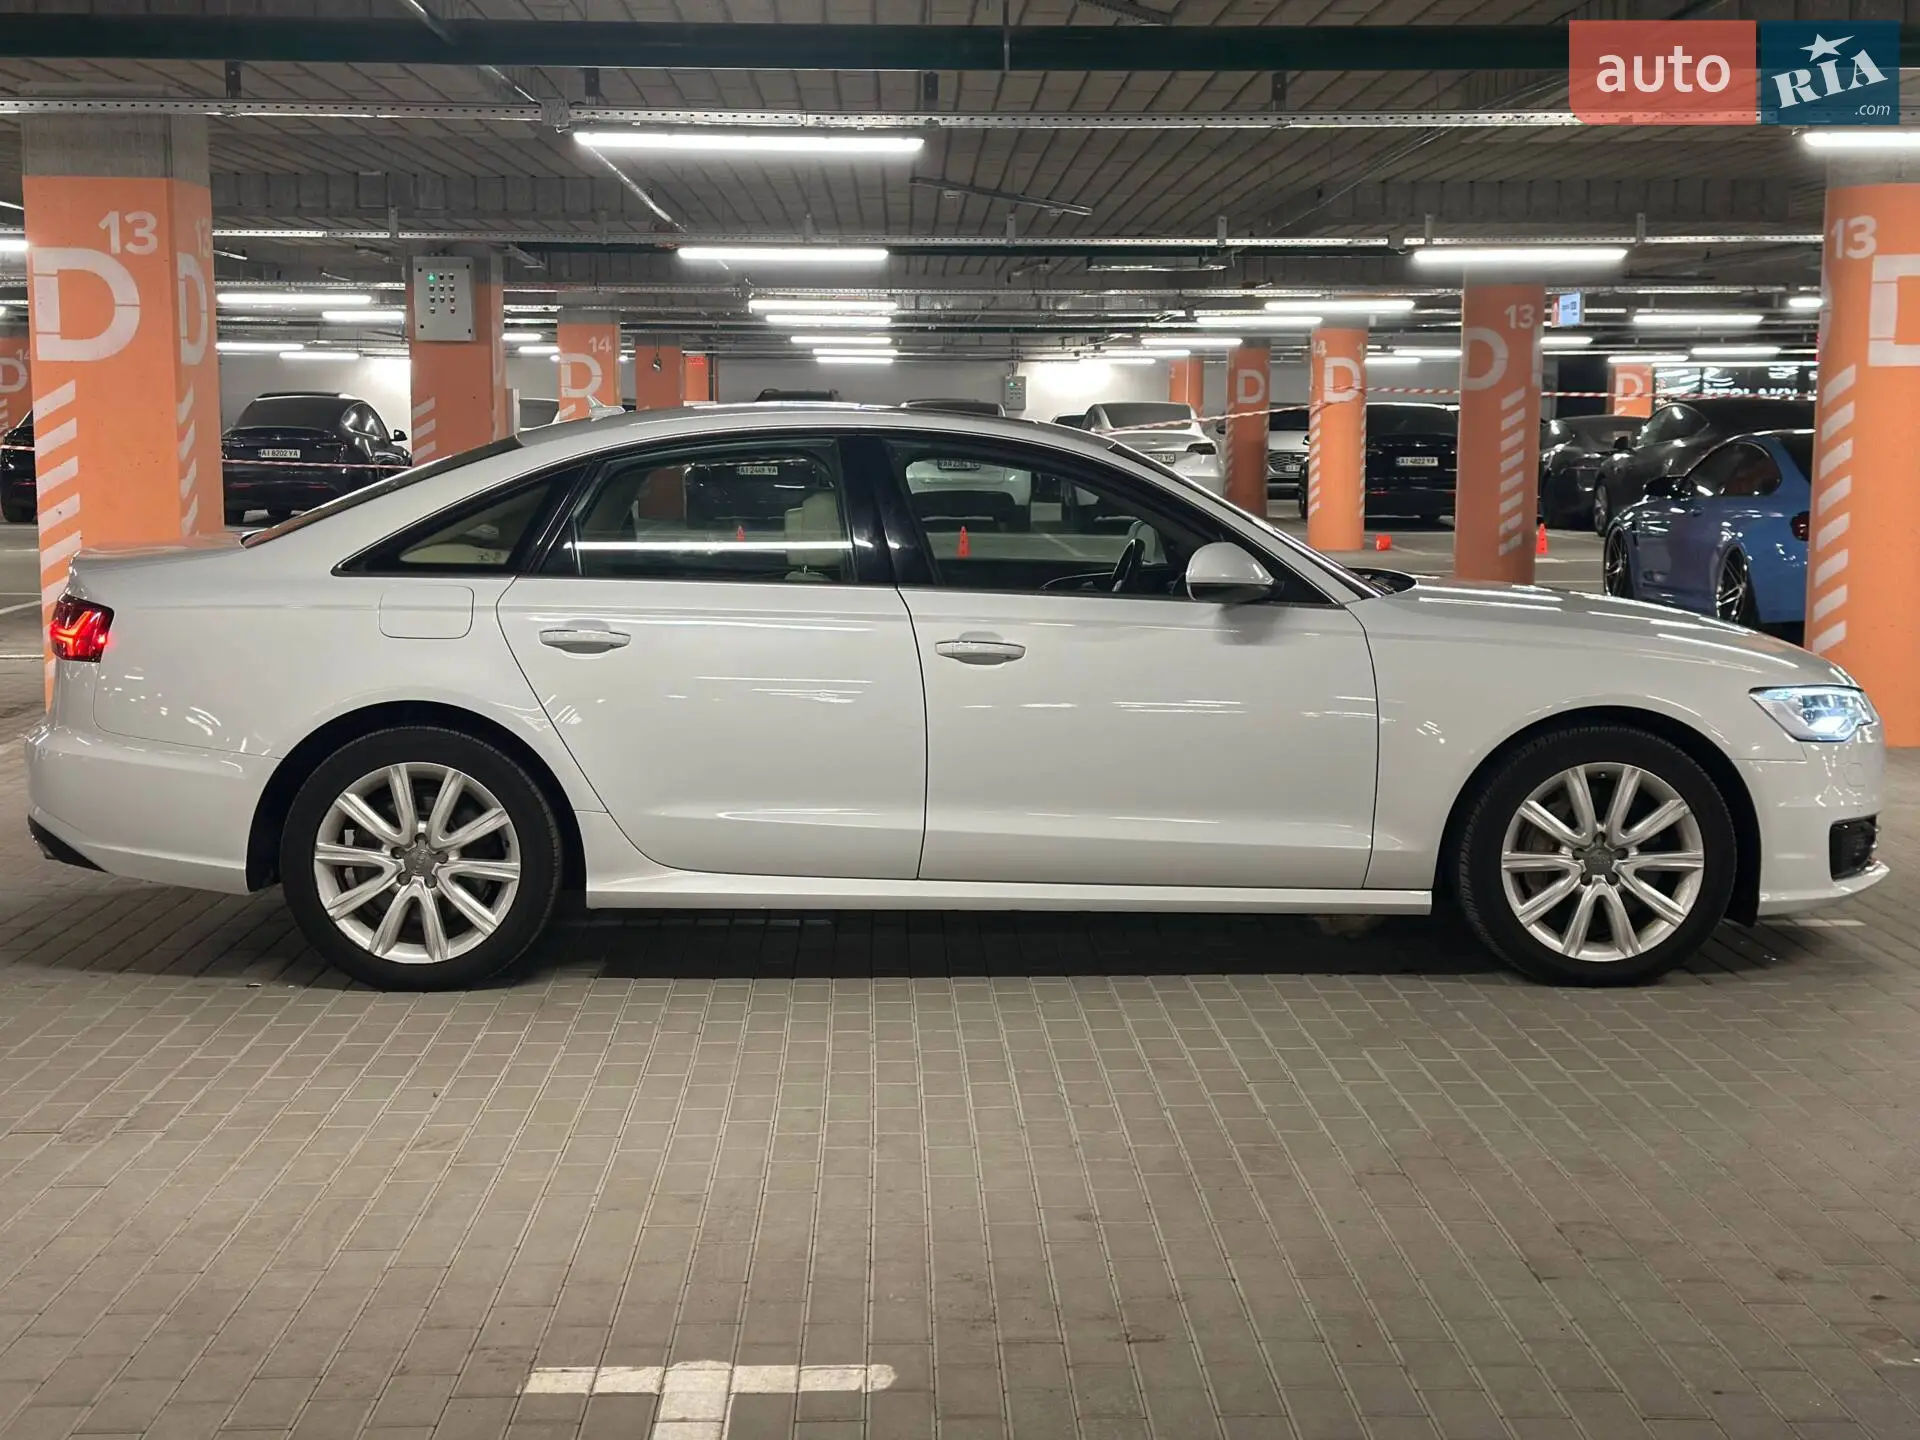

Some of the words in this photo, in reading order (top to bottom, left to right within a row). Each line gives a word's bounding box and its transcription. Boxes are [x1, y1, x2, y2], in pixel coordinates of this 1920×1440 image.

[98, 210, 158, 255] 13
[1831, 215, 1877, 259] 13
[32, 246, 141, 362] D
[177, 251, 208, 365] D
[1504, 303, 1535, 329] 13
[588, 335, 612, 353] 14
[1462, 326, 1509, 391] D
[558, 352, 602, 398] D
[1237, 369, 1265, 404] D
[1323, 356, 1361, 403] D
[1615, 373, 1643, 400] D
